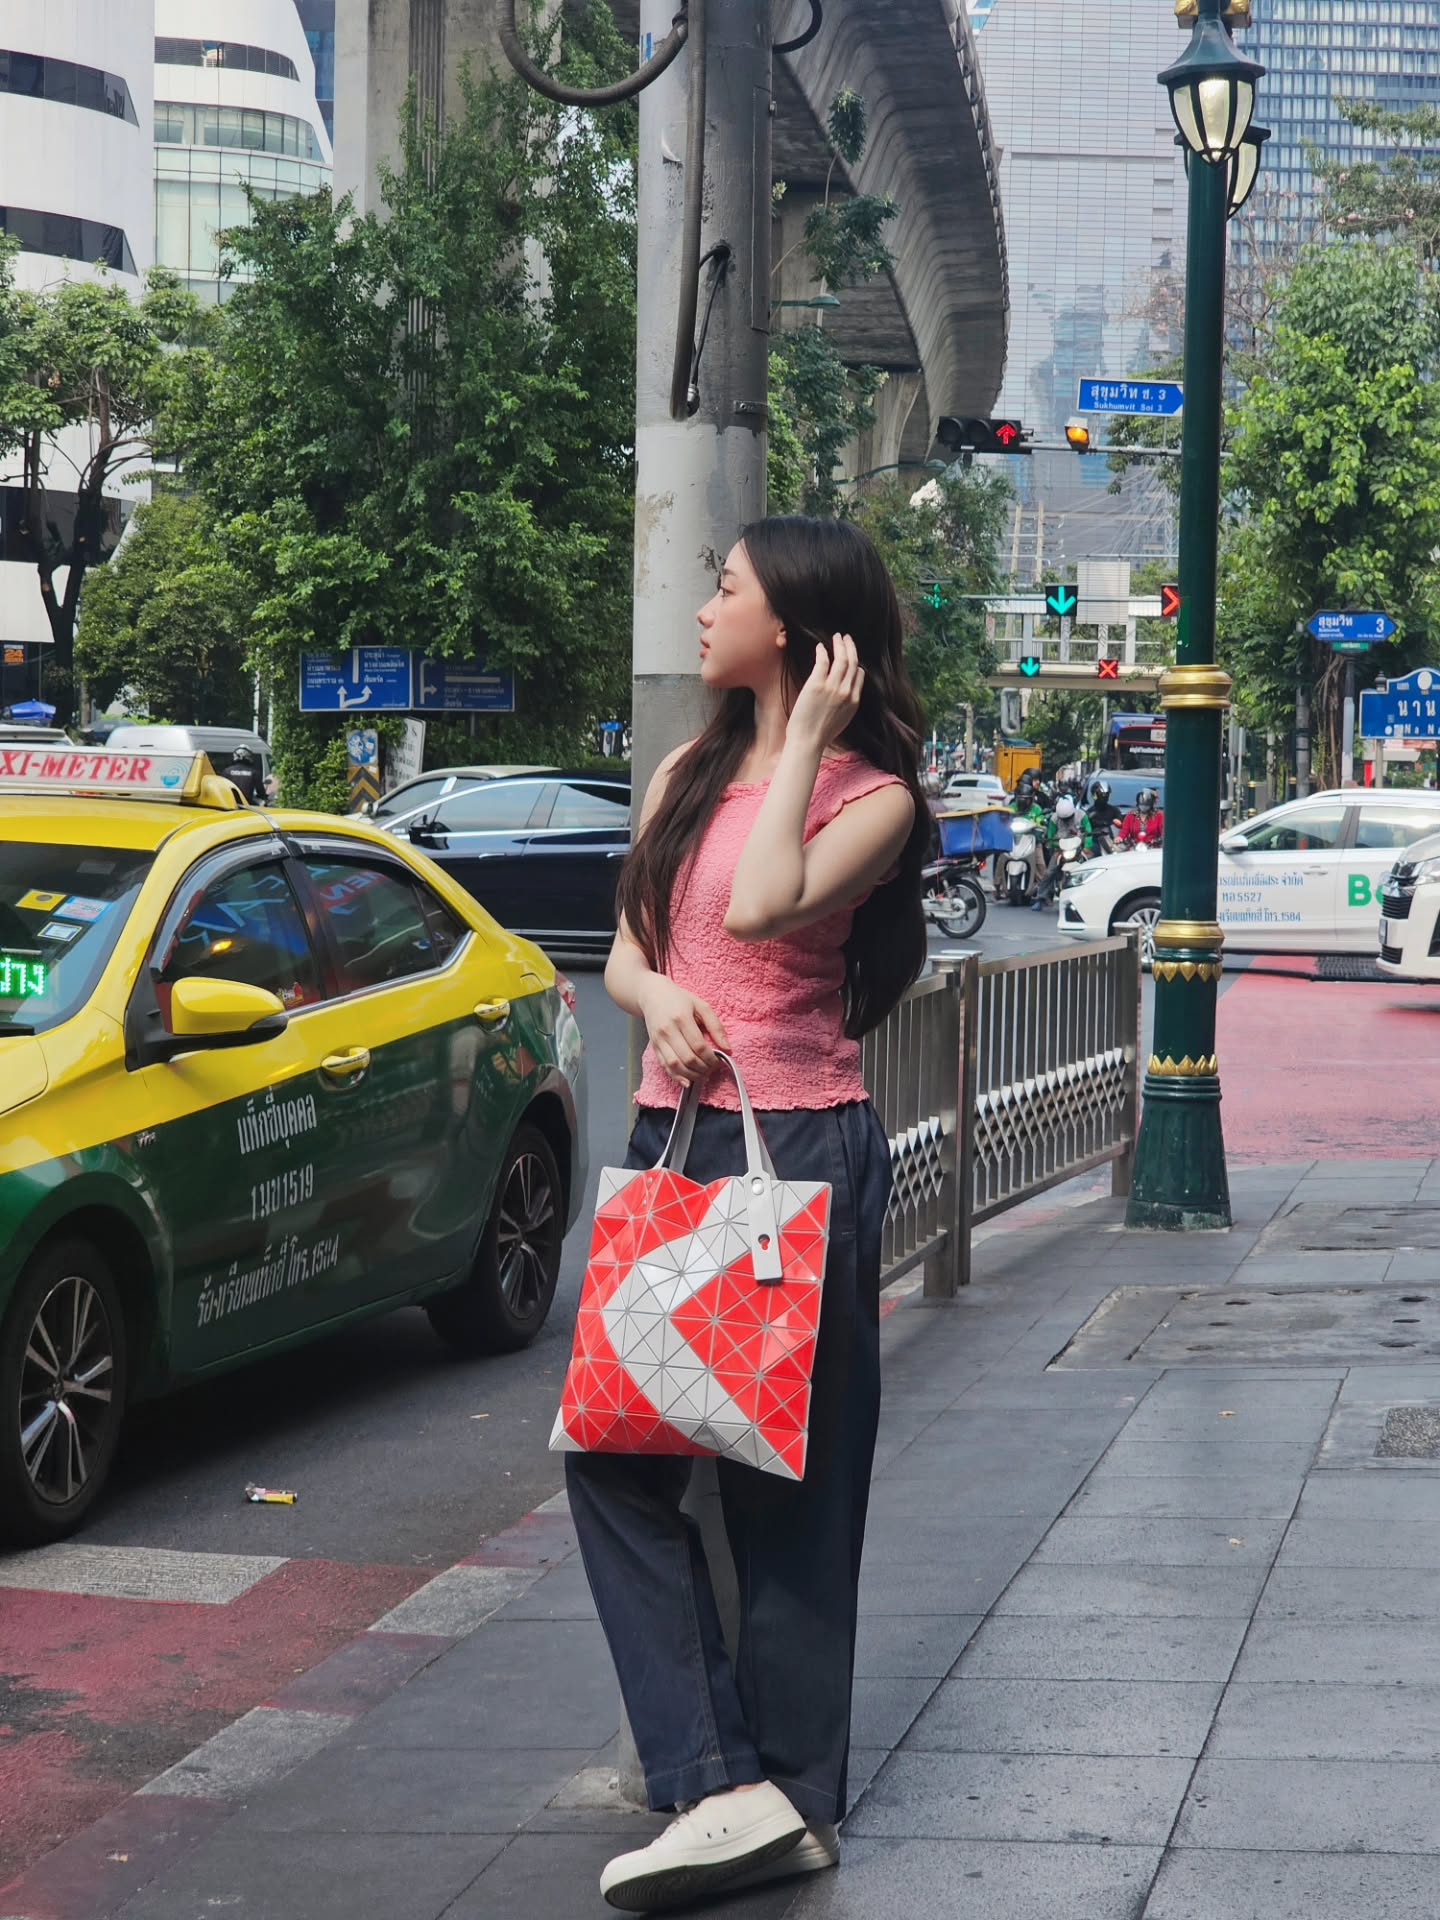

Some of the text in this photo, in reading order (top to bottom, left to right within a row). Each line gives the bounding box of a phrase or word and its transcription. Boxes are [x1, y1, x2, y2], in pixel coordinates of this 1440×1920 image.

[1090, 383, 1138, 401] สุขุมวิท
[1158, 389, 1167, 400] 3
[1093, 401, 1136, 410] Sukhumvit
[1140, 403, 1153, 412] Soi
[1318, 614, 1385, 633] สุขุมวิท 3
[237, 1085, 317, 1155] แท็กซี่บุคคล
